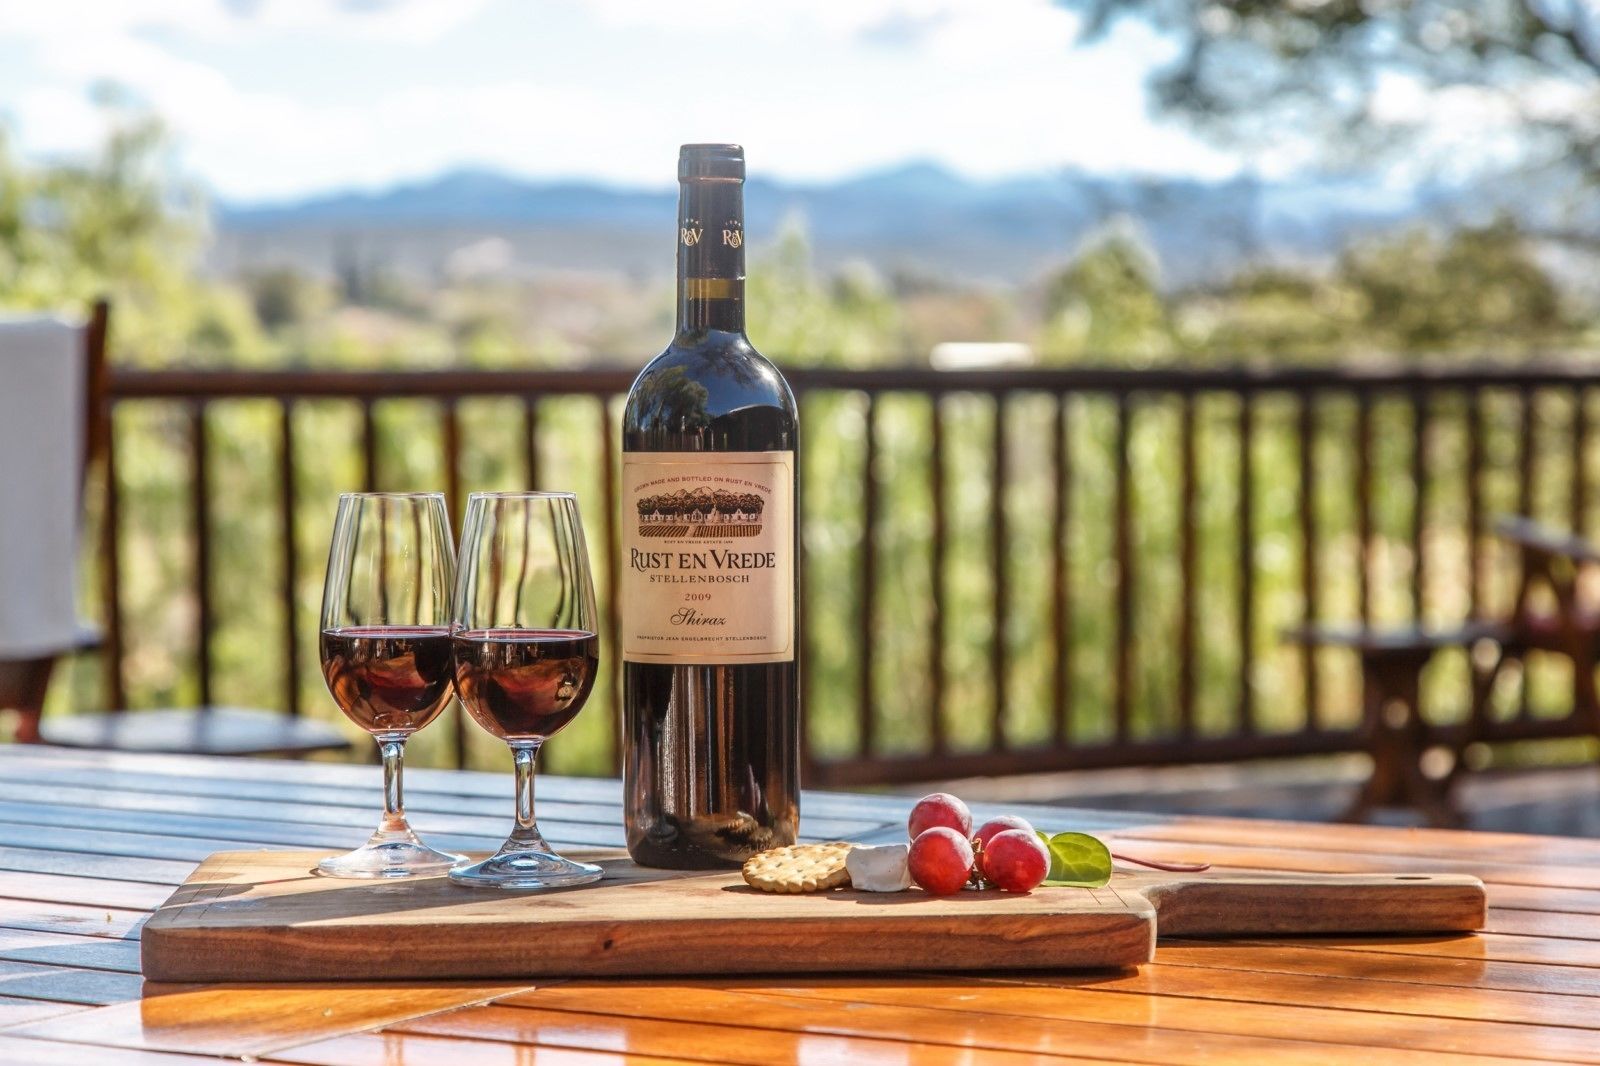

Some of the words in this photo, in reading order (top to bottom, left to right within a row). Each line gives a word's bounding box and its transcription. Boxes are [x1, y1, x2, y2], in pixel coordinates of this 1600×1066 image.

[754, 483, 772, 495] VREDE
[631, 548, 673, 573] RUST
[679, 553, 707, 569] EN
[708, 549, 776, 569] VREDE
[650, 574, 750, 583] STELLENBOSCH
[684, 593, 712, 601] 2009
[670, 607, 727, 626] Shiraz
